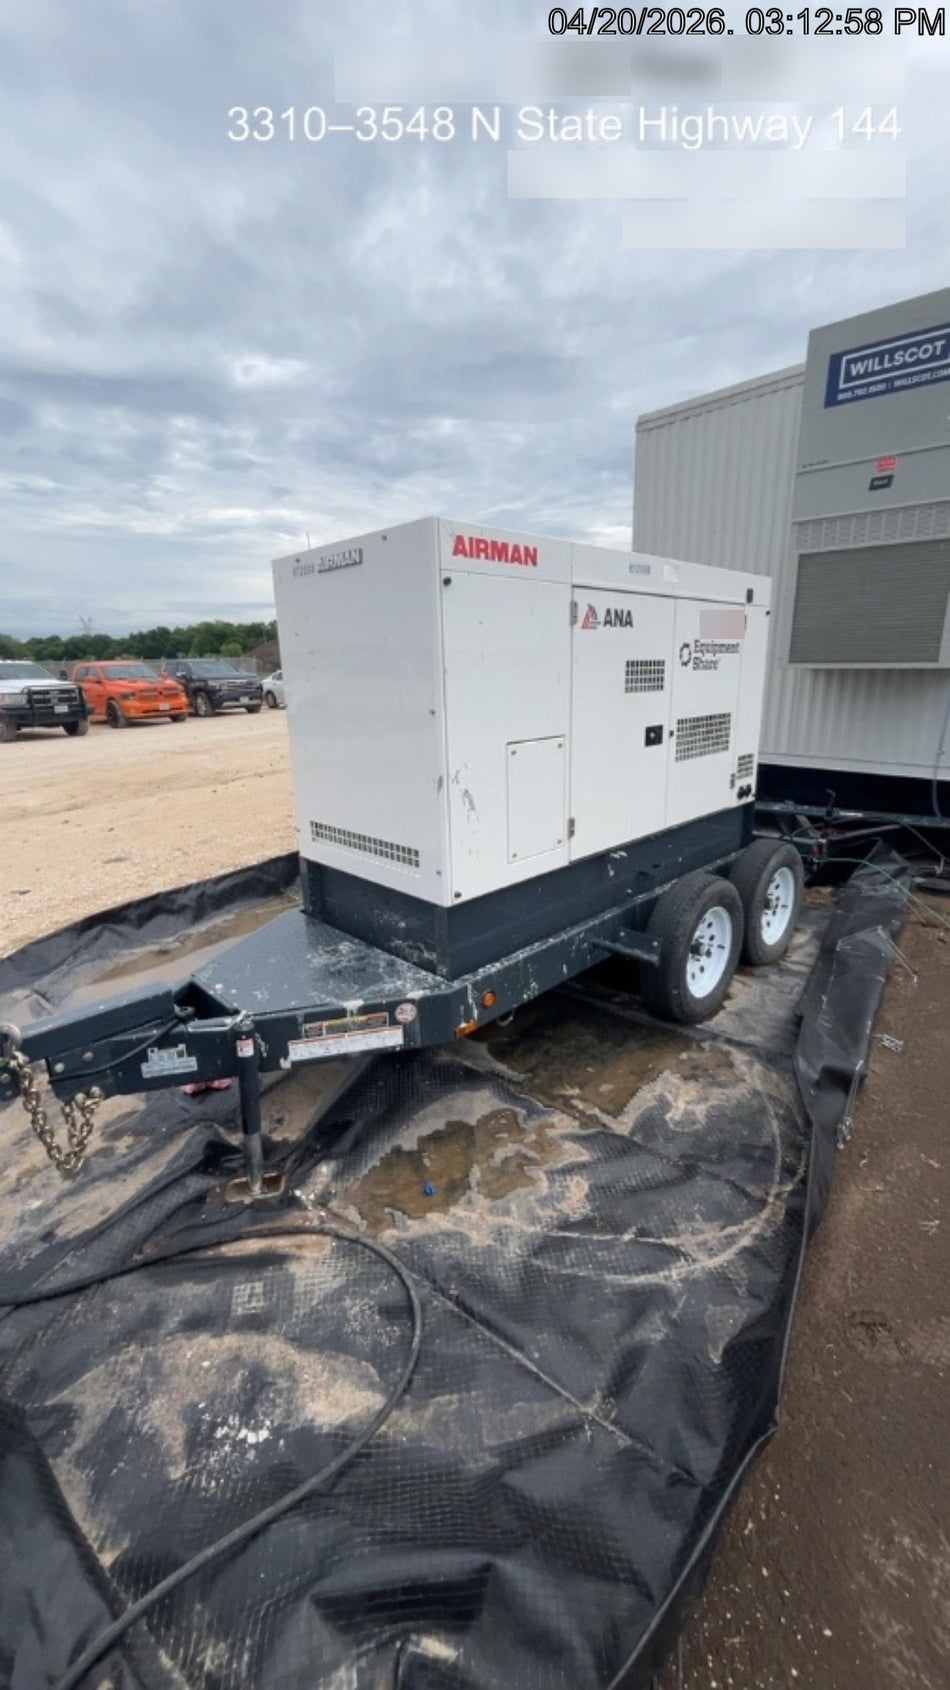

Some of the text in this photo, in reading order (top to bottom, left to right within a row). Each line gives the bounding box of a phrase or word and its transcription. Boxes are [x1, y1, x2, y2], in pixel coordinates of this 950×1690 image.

[850, 340, 947, 377] WILLSCOT
[317, 548, 363, 573] AIRMAN
[452, 535, 538, 567] AIRMAN
[603, 608, 634, 628] ANA
[694, 639, 740, 657] Equipment
